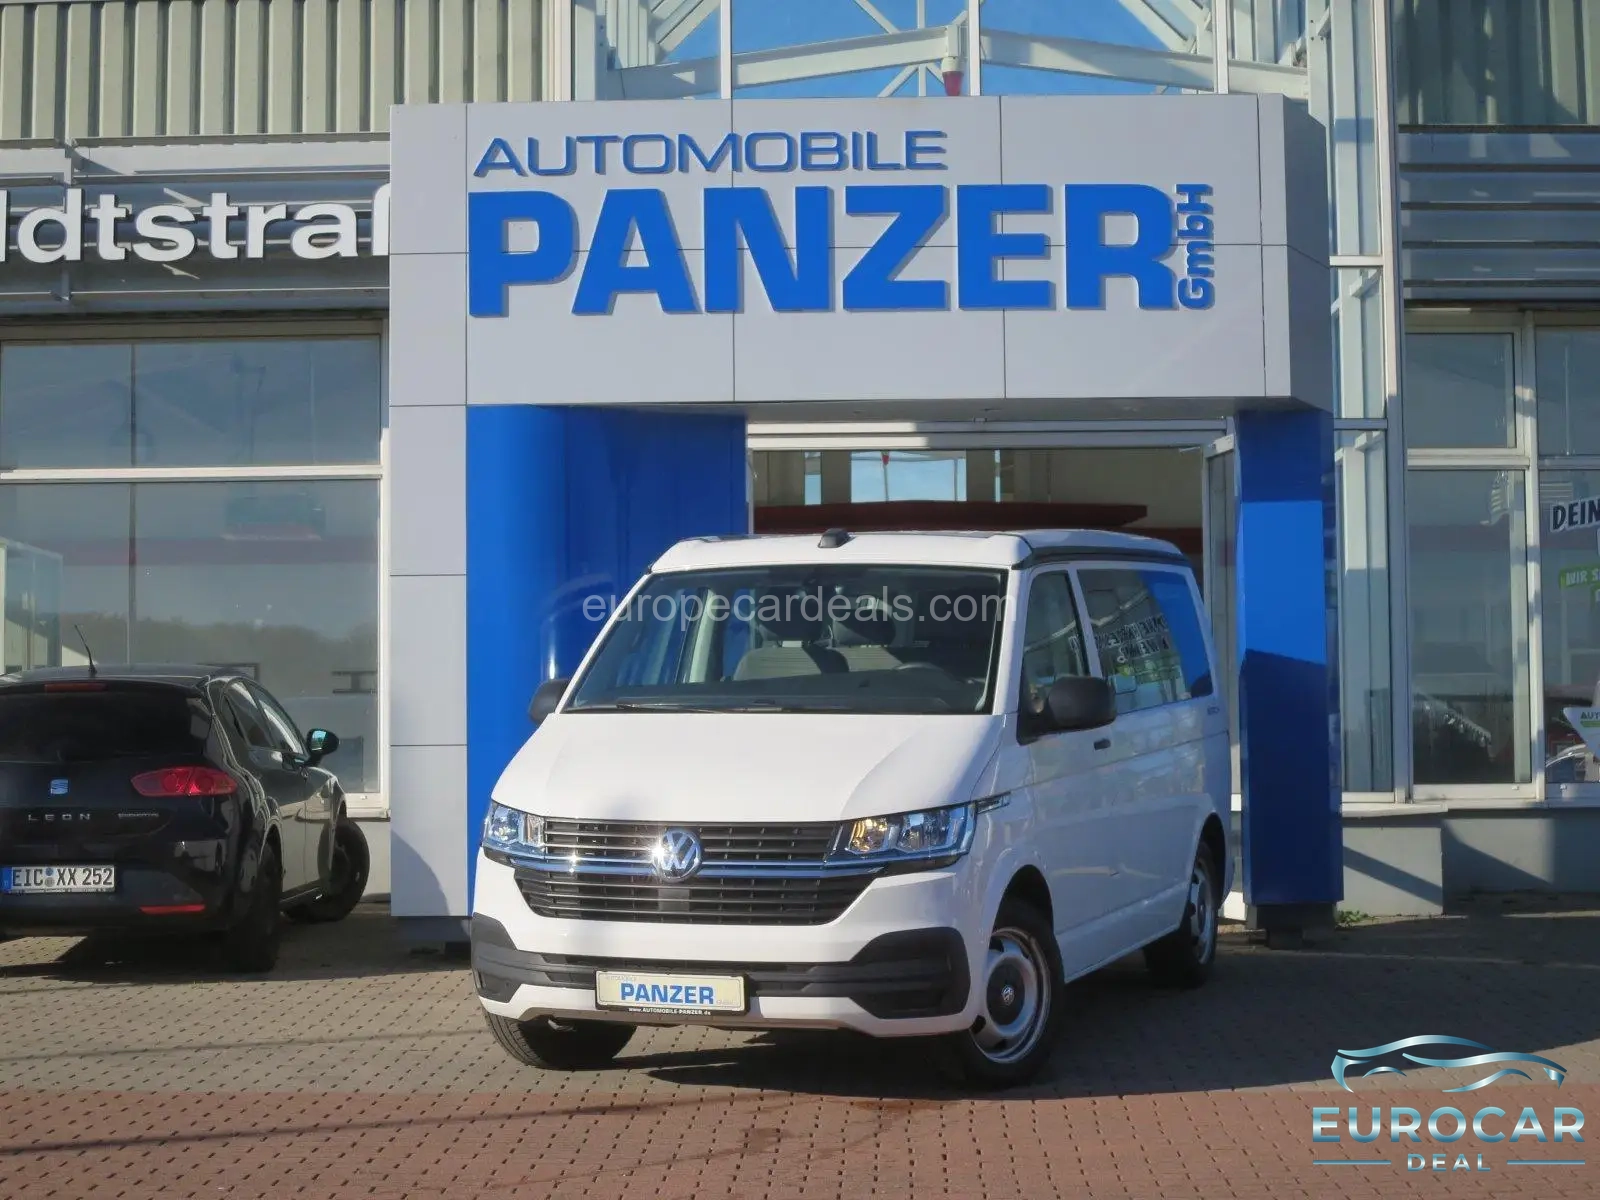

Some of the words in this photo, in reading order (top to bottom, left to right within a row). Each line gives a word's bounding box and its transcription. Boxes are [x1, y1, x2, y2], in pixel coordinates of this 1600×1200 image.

[473, 130, 948, 176] AUTOMOBILE
[469, 184, 1178, 317] PANZER
[1176, 183, 1215, 310] GmbH
[28, 813, 91, 821] LEON
[13, 867, 43, 887] EIC
[56, 867, 77, 886] XX
[82, 867, 113, 886] 252
[620, 983, 714, 1005] PANZER
